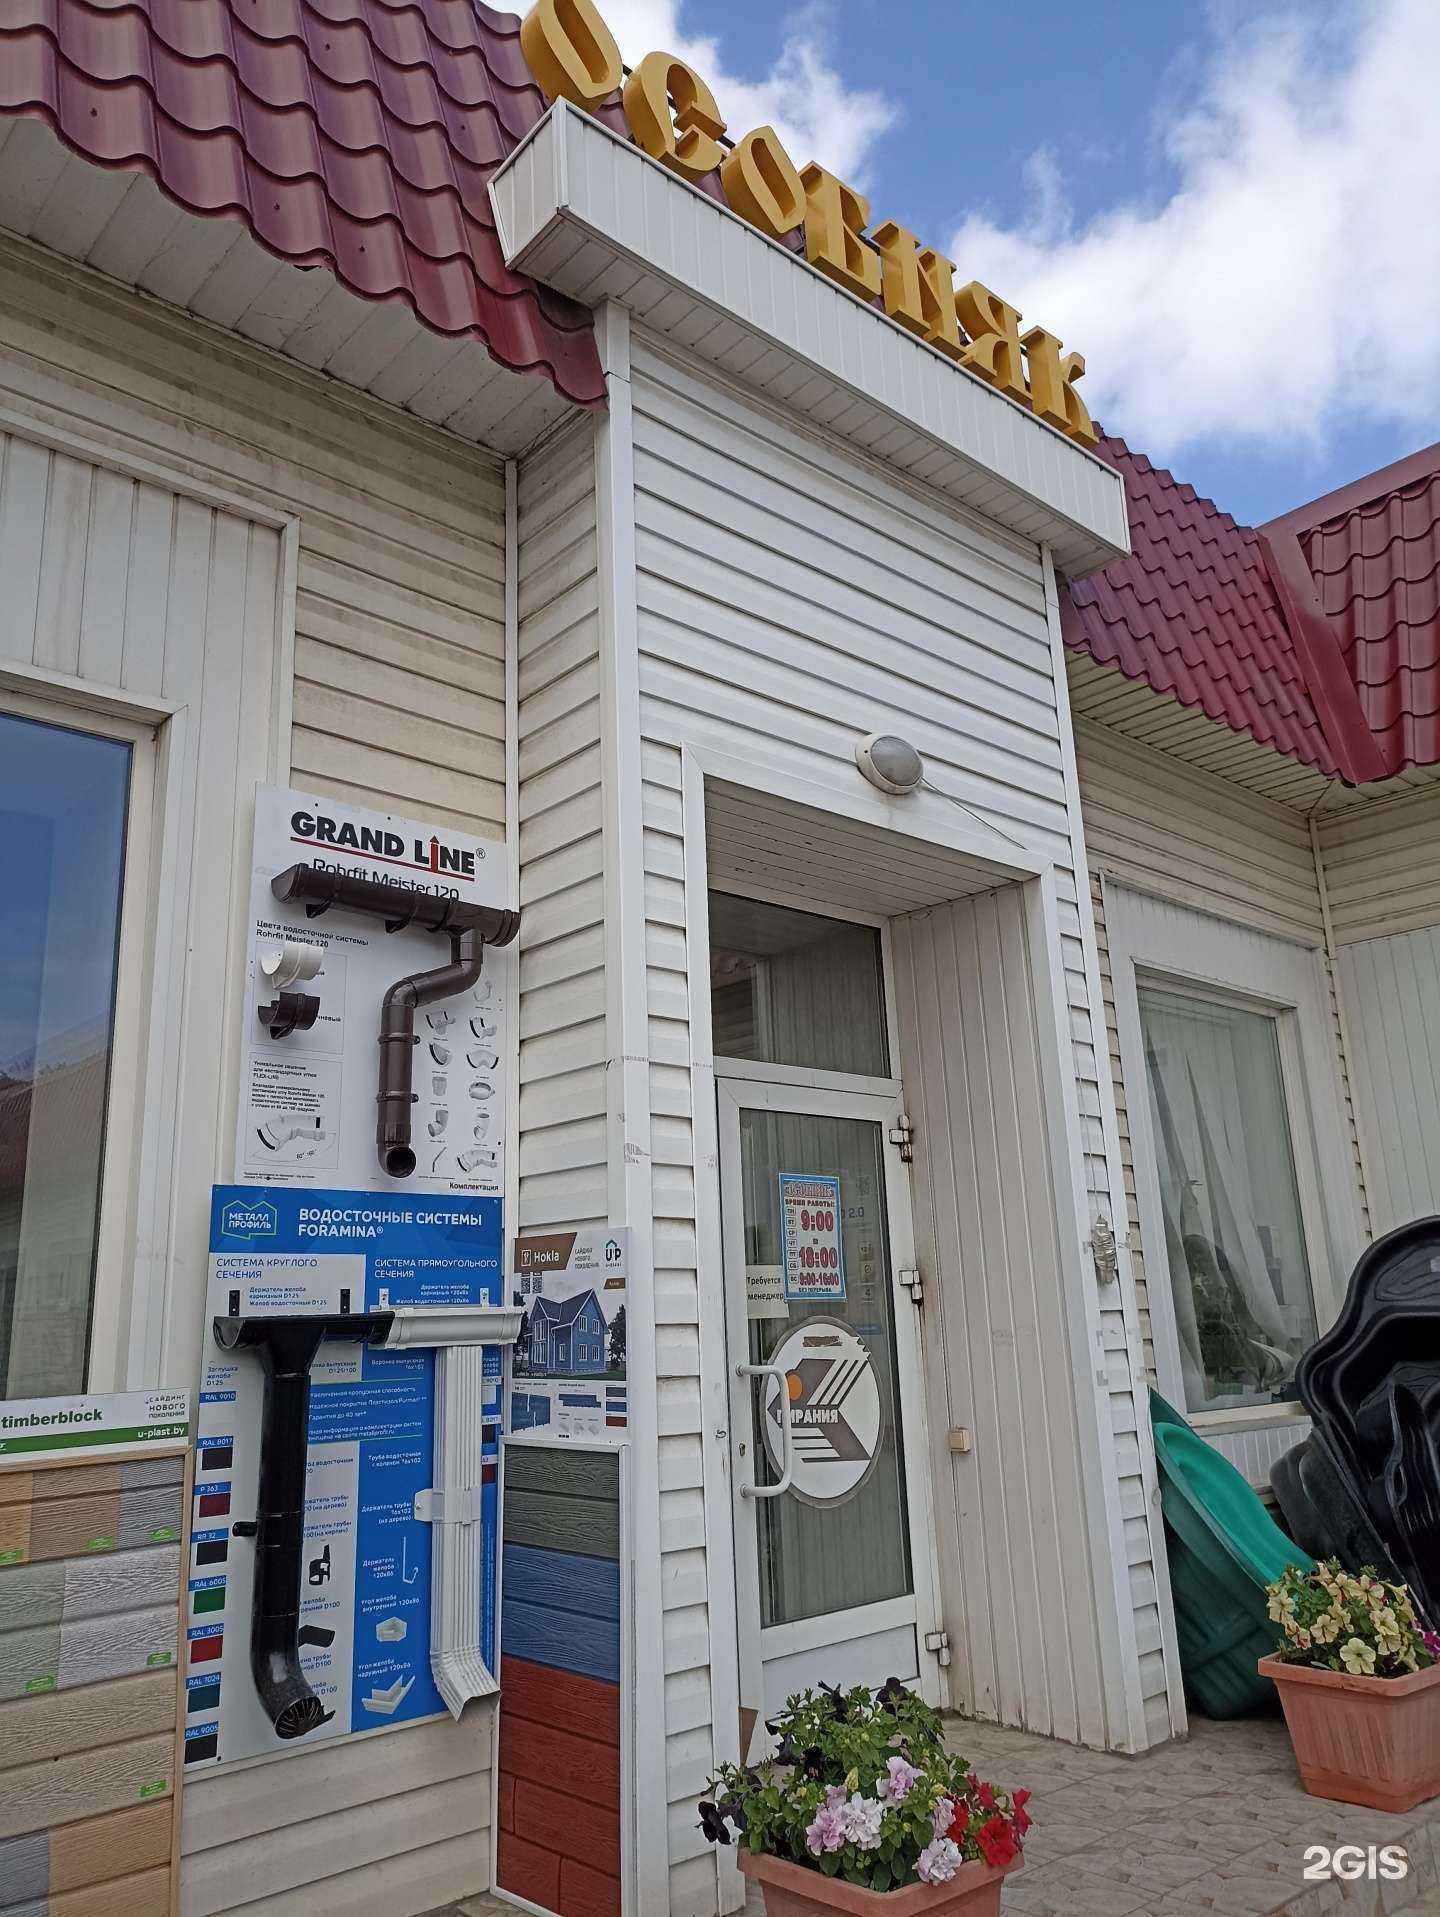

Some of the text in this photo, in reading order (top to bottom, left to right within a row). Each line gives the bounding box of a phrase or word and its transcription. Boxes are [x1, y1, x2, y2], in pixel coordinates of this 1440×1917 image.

[520, 0, 1100, 447] ОСОБНЯК
[291, 811, 405, 857] GRAND
[372, 870, 432, 893] Meister
[433, 884, 460, 900] 120
[256, 920, 369, 946] Цвета водосточной системы
[256, 929, 283, 940] Rohrfit
[449, 1182, 499, 1191] Комплектация
[229, 1212, 269, 1221] МЕТАЛЛ
[299, 1208, 482, 1226] ВОДОСТОЧНЫЕ СИСТЕМЫ
[800, 1209, 834, 1231] 9:00
[229, 1220, 272, 1229] ПРОФИЛЬ
[534, 1250, 560, 1262] Hokla
[605, 1248, 622, 1262] UP
[799, 1246, 838, 1269] 18:00
[216, 1258, 318, 1268] СИСТЕМА КРУГЛОГО
[374, 1259, 498, 1268] СИСТЕМА ПРЯМОУГОЛЬНОГО
[216, 1270, 262, 1279] СЕЧЕНИЯ
[374, 1269, 414, 1278] СЕЧЕНИЯ
[746, 1275, 781, 1286] Требуется
[747, 1292, 784, 1301] менеджер
[1, 1408, 103, 1429] timberblock
[137, 1426, 185, 1438] u-plast.by
[194, 1577, 226, 1588] RAL 6005
[191, 1625, 224, 1637] RAL 3005
[188, 1679, 202, 1687] RAL
[185, 1729, 200, 1738] RAL
